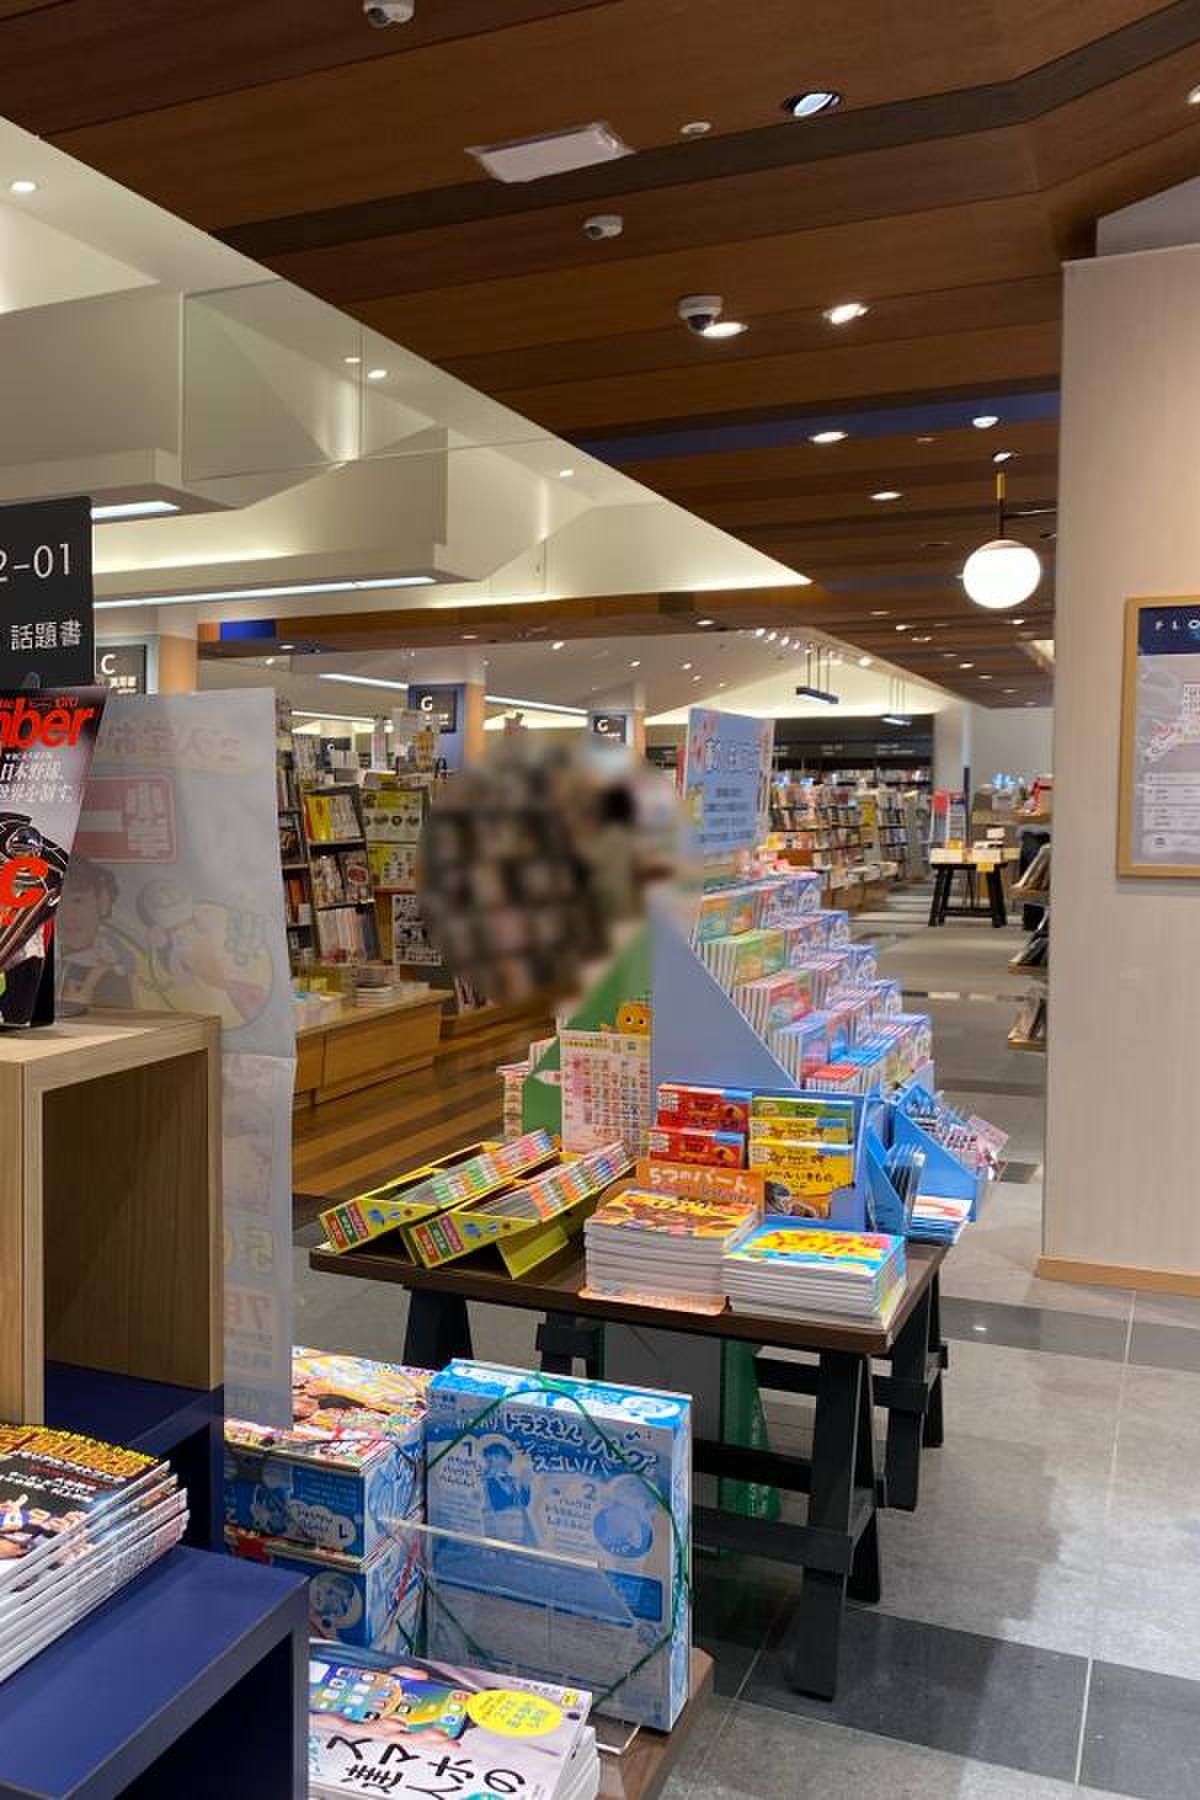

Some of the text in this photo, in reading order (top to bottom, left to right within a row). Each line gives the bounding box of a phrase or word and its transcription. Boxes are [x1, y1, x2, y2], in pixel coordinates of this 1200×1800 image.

[101, 653, 116, 675] C
[504, 1410, 583, 1444] ドラえもん
[326, 1734, 526, 1793] スマホの
